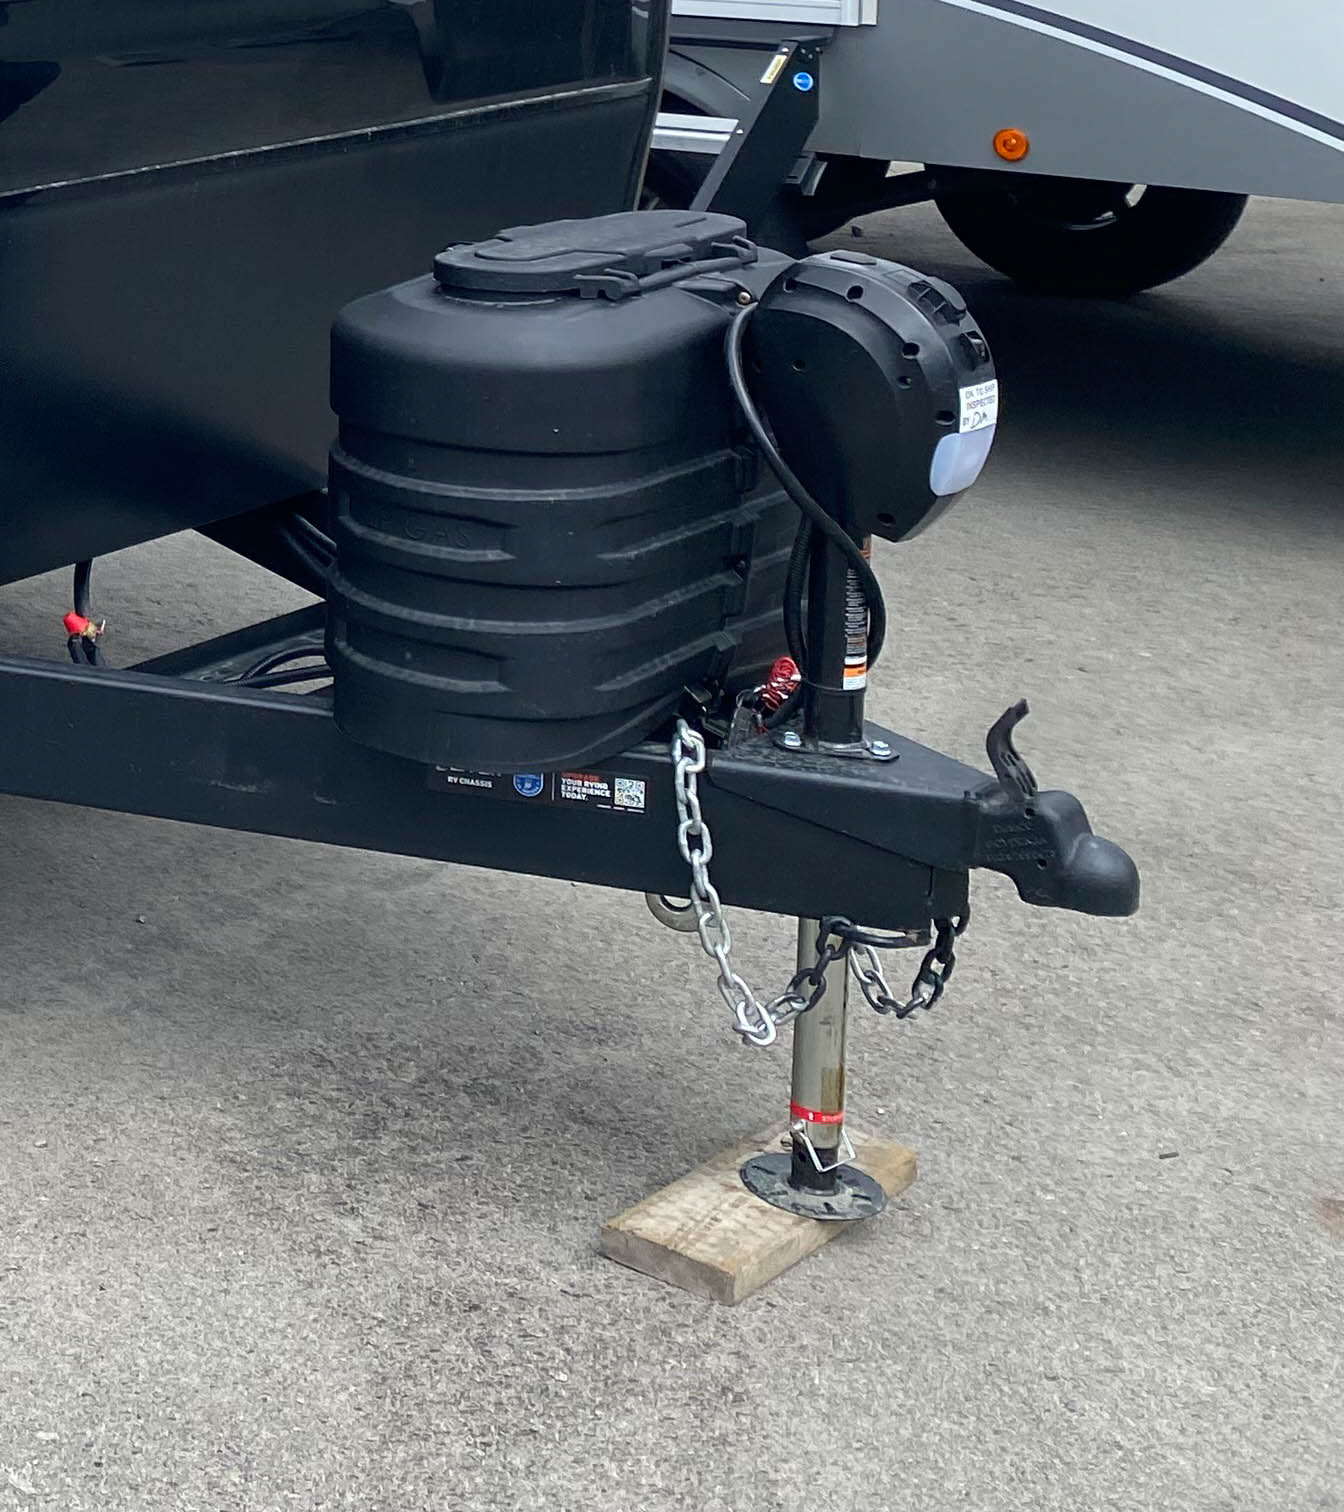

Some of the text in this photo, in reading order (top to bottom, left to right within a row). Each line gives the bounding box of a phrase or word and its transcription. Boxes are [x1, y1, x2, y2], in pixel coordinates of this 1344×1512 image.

[459, 776, 493, 789] CHASSIS
[561, 777, 582, 787] YOUR
[561, 784, 611, 798] EXPERIENCE
